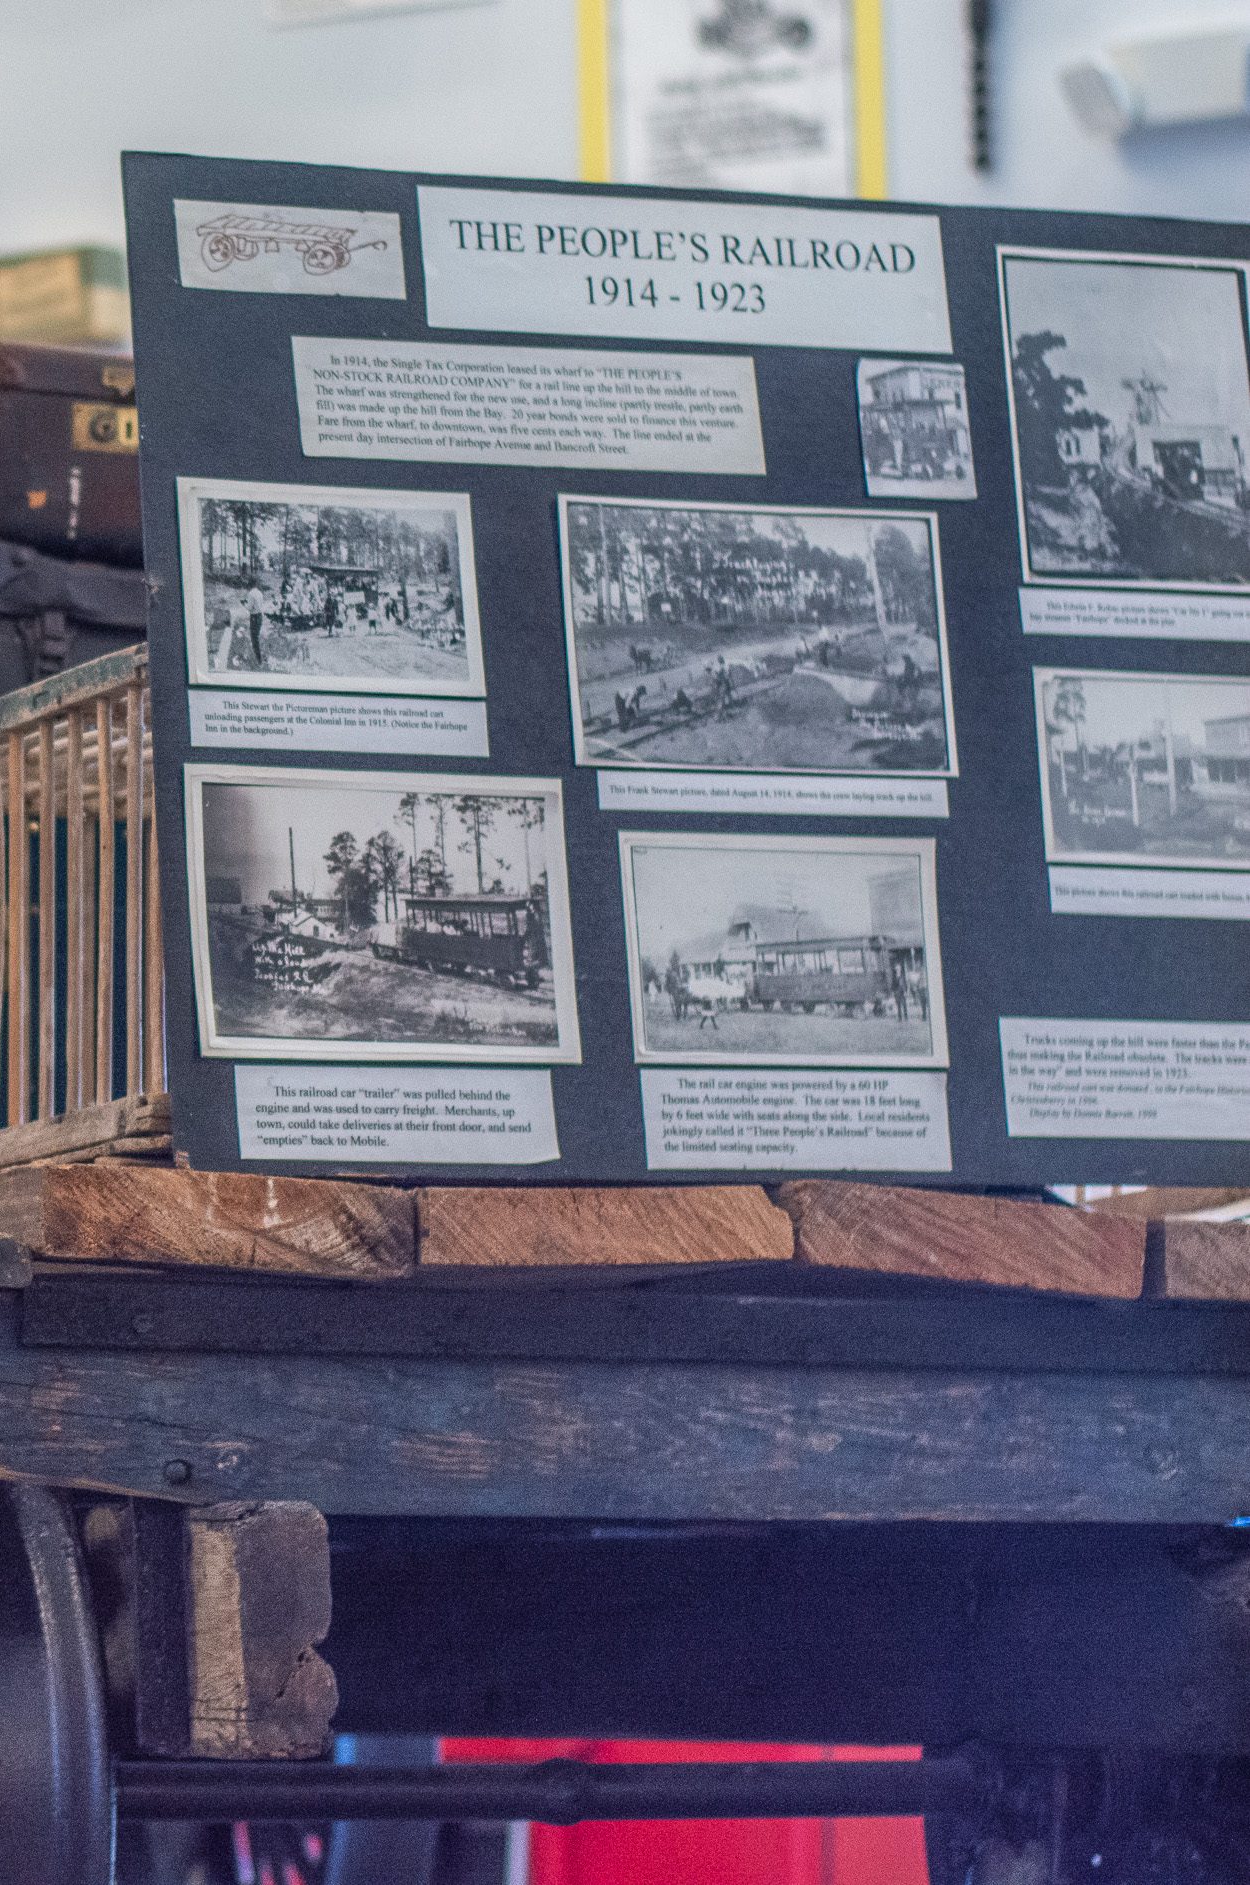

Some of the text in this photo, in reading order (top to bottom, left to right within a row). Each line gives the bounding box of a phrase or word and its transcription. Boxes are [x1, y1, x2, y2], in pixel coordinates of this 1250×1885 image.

[450, 219, 916, 274] THE PEOPLE'S RAILROAD
[584, 275, 658, 308] 1914
[694, 280, 766, 313] 1923
[329, 355, 341, 366] In
[372, 356, 388, 368] the
[391, 357, 422, 373] Single
[425, 359, 443, 371] Tax
[445, 360, 504, 376] Corporation
[507, 362, 537, 375] leased
[539, 364, 551, 375] its
[554, 364, 582, 377] wharf
[583, 367, 594, 377] to
[627, 367, 683, 381] PEOPLE'S
[313, 368, 382, 382] NON-STOCK
[386, 371, 448, 385] RAILROAD
[518, 377, 532, 389] for
[535, 381, 541, 389] a
[543, 378, 560, 390] rail
[562, 379, 580, 391] line
[583, 383, 595, 395] up
[597, 381, 612, 393] the
[615, 382, 631, 393] hill
[633, 384, 643, 394] to
[646, 383, 660, 395] the
[664, 384, 696, 396] middle
[700, 385, 710, 397] of
[316, 383, 334, 395] The
[336, 384, 365, 397] wharf
[368, 388, 386, 398] was
[389, 387, 451, 403] strengthened
[453, 389, 467, 401] for
[469, 390, 485, 402] the
[487, 394, 507, 403] new
[317, 414, 339, 426] Fare
[342, 415, 366, 427] from
[367, 416, 383, 428] the
[419, 420, 430, 430] to
[432, 419, 486, 435] downtown,
[488, 424, 508, 434] was
[510, 423, 529, 435] five
[531, 425, 556, 436] cents
[558, 425, 581, 437] each
[318, 430, 353, 445] present
[356, 431, 373, 446] day
[377, 432, 433, 445] intersection
[435, 434, 446, 446] of
[448, 435, 491, 451] Fairhope
[495, 437, 531, 450] Avenue
[533, 439, 551, 451] and
[554, 440, 595, 453] Bancroft
[205, 723, 294, 738] Inn in the background.)
[273, 1086, 511, 1103] This railroad car "trailer" was pulled behind the
[255, 1101, 516, 1120] engine and was used to carry freight. Merchants, up
[255, 1118, 532, 1134] town, could take deliveries at their front door, and send
[257, 1133, 390, 1149] "empties" back to Mobile.
